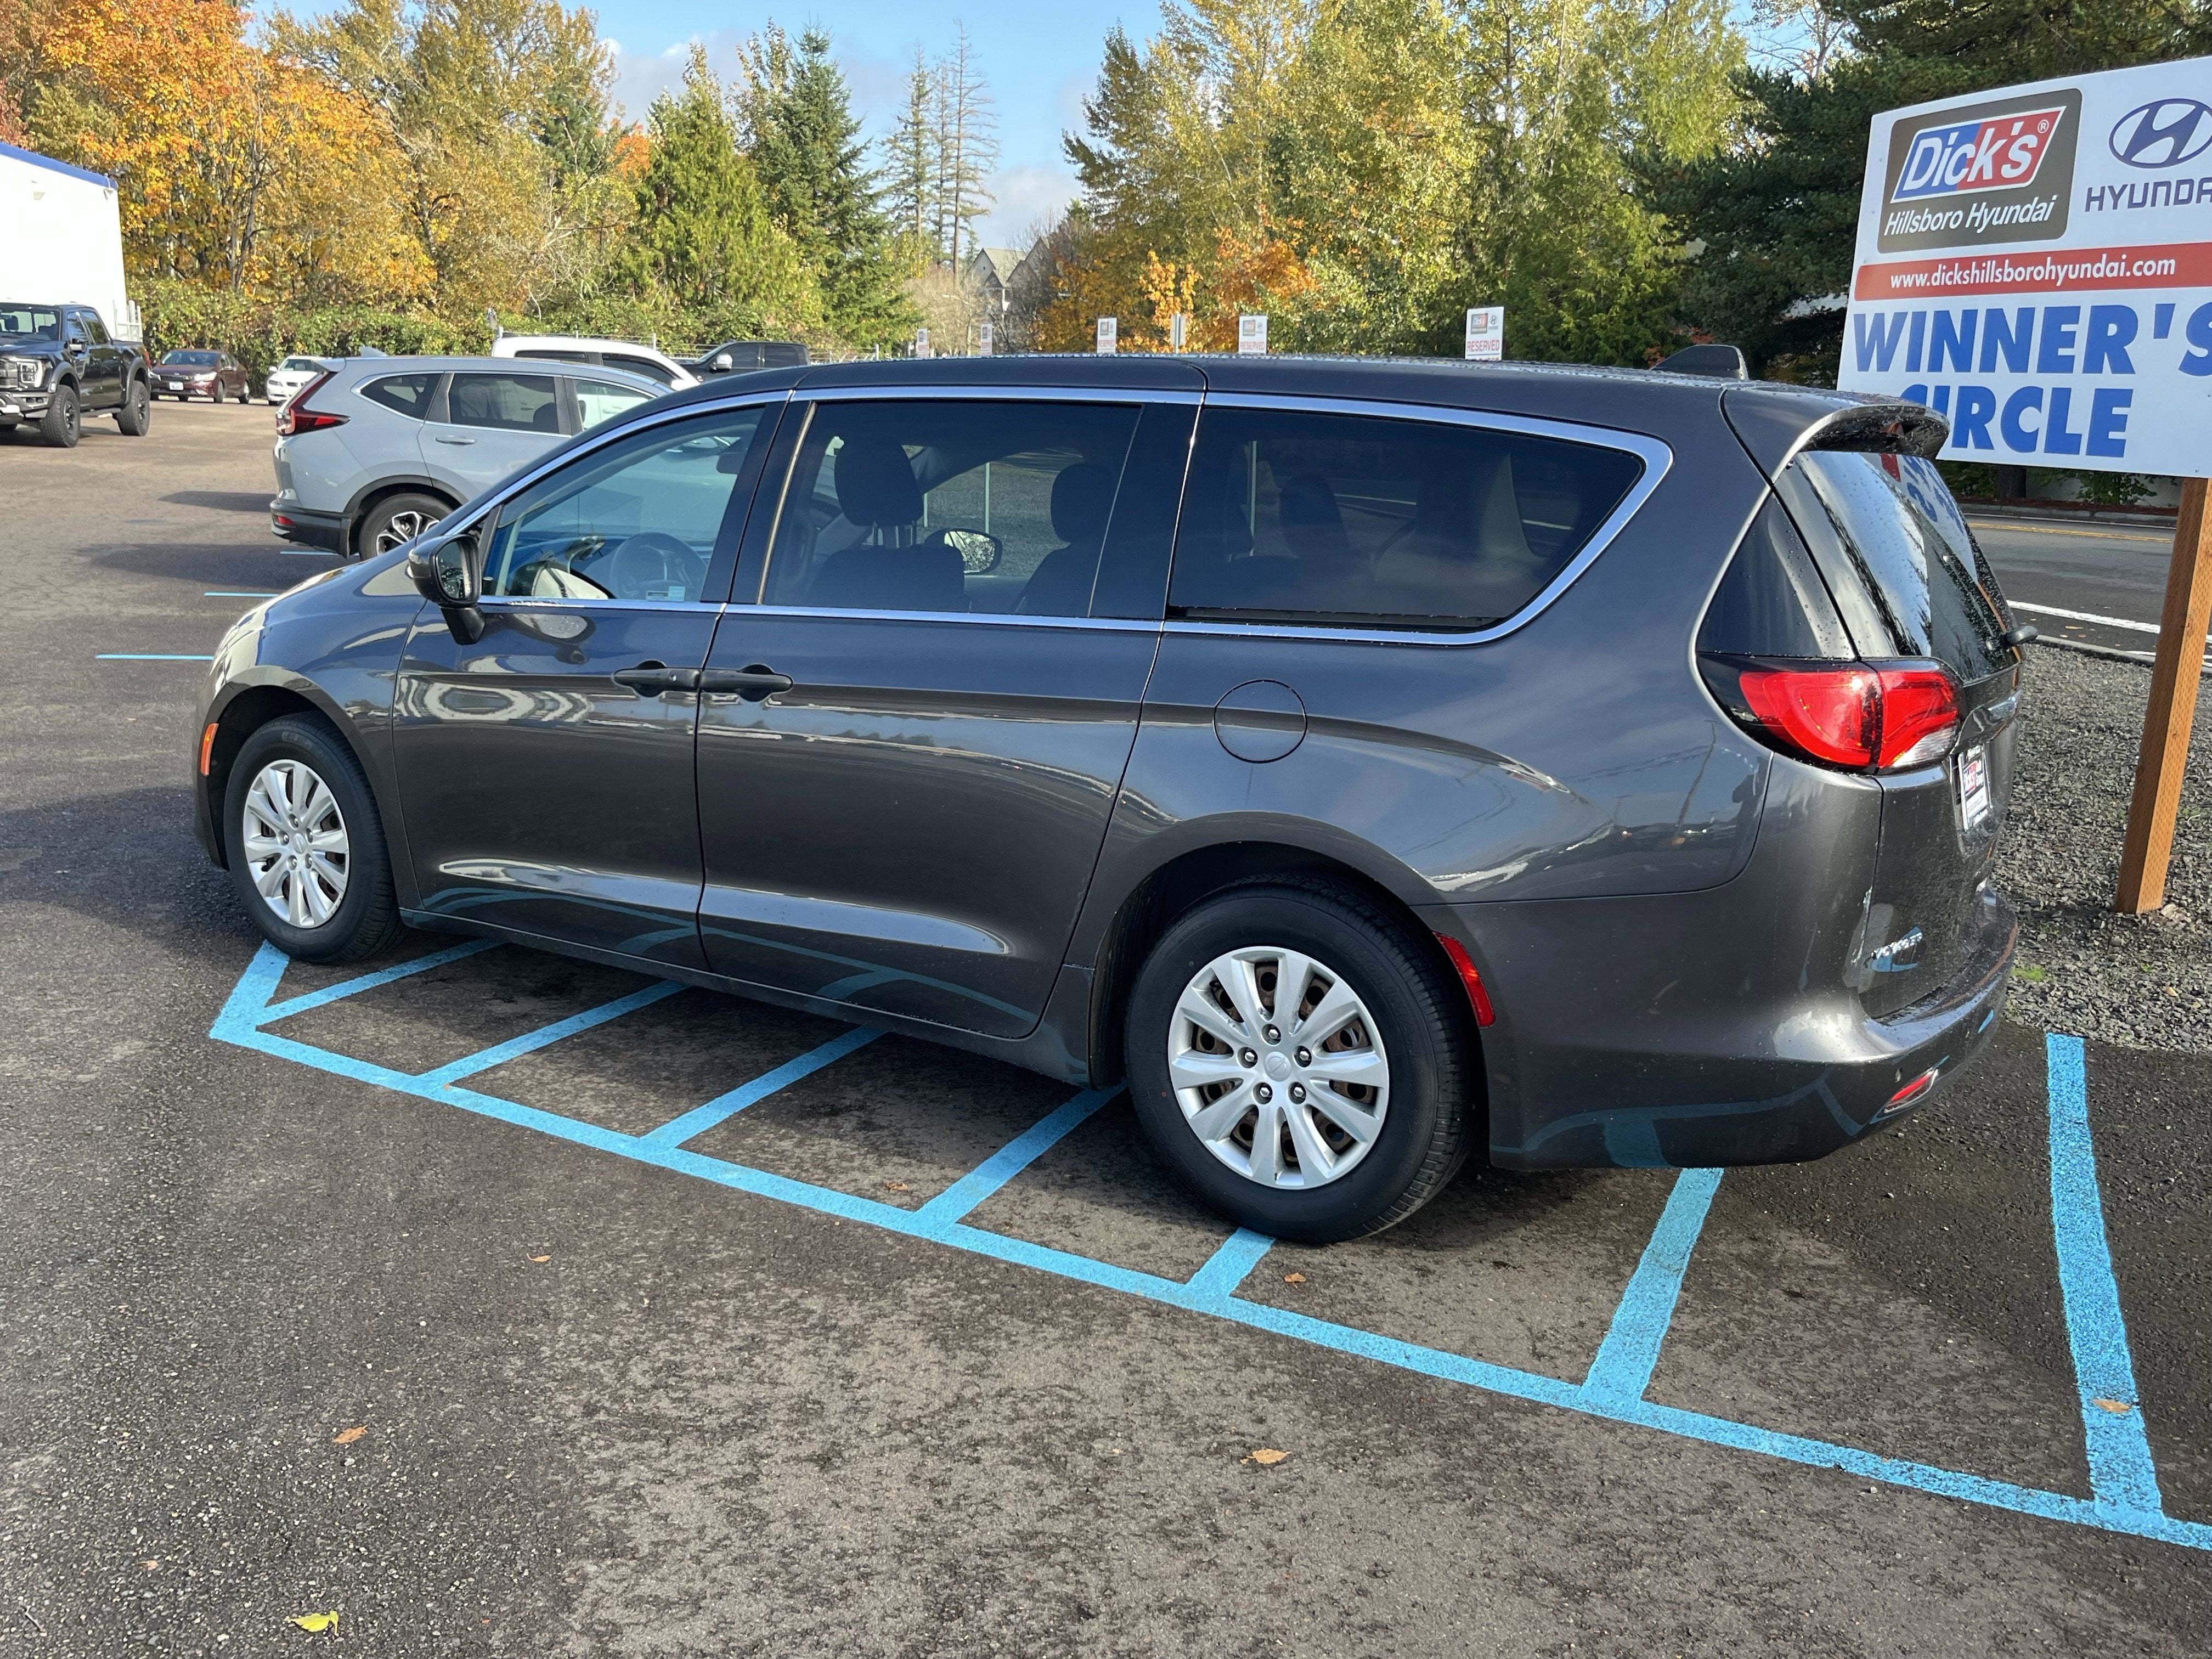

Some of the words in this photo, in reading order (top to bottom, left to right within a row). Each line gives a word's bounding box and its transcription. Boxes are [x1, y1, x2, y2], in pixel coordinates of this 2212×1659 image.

[1884, 208, 1963, 236] Hillsboro
[1965, 195, 2057, 234] Hyundai
[1891, 253, 2176, 289] www.dickshillsborohyundai.com
[1466, 340, 1500, 352] RESERVED
[1853, 302, 2212, 377] WINNER'S
[1900, 384, 2134, 458] RCLE
